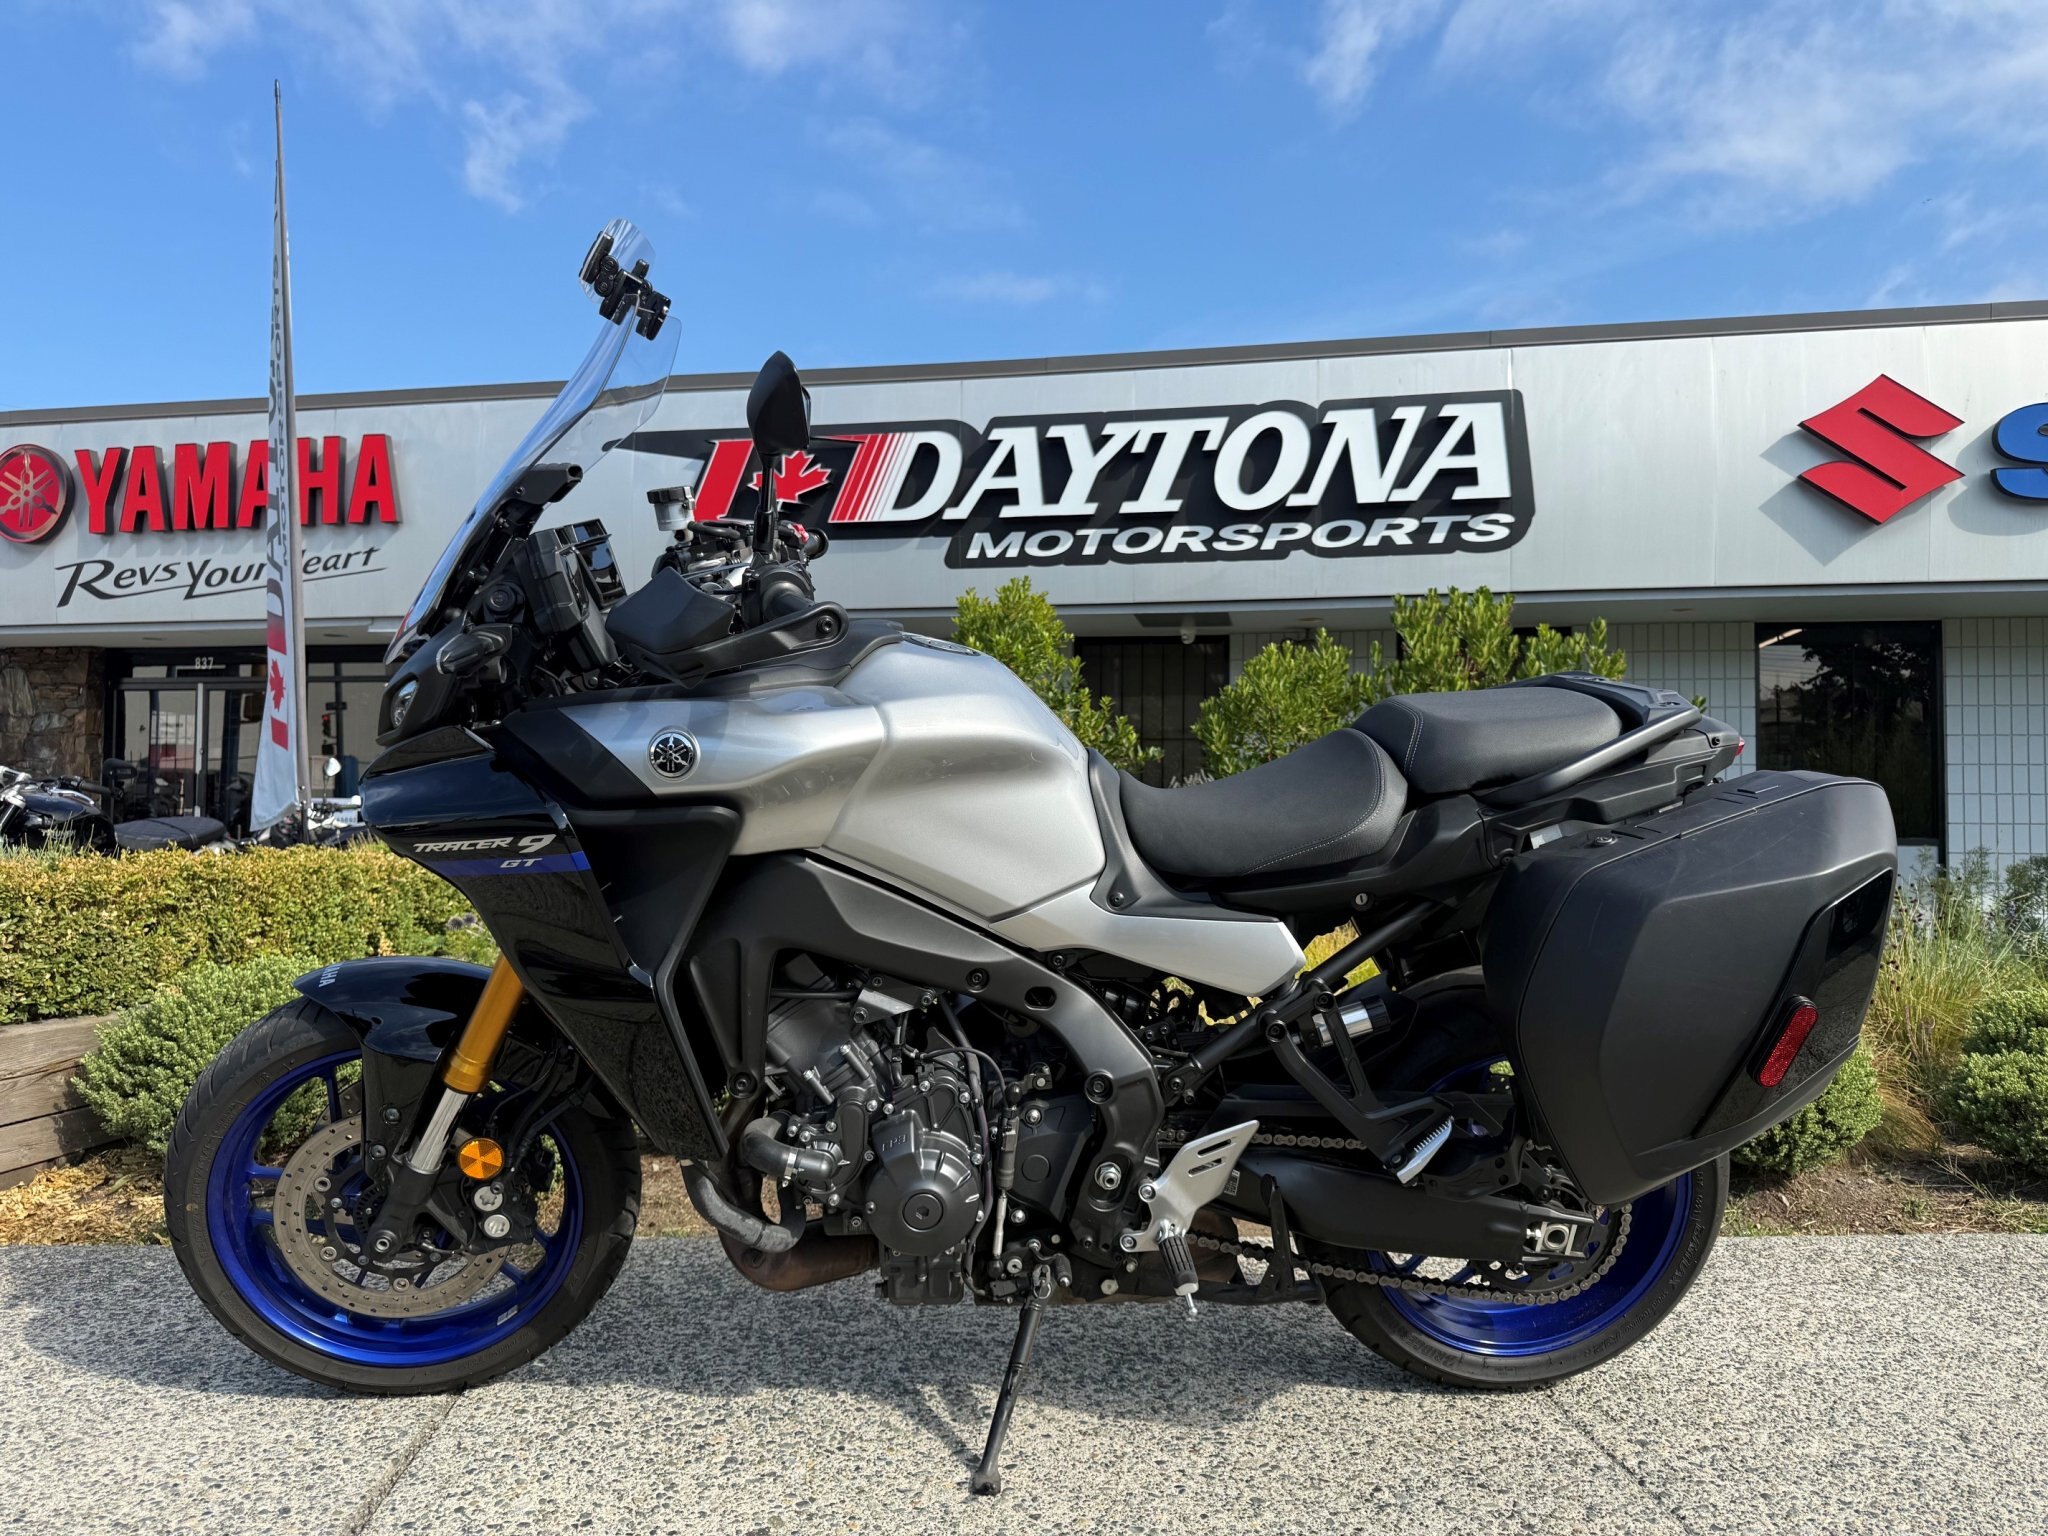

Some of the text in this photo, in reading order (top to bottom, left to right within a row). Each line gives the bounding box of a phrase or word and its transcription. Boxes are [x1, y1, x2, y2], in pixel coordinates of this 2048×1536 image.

[878, 402, 1512, 521] DAYTONA
[965, 513, 1516, 559] MOTORSPORTS
[55, 559, 183, 608] Revs
[302, 546, 381, 575] eart
[195, 656, 214, 670] 837
[413, 834, 557, 854] TRACER 9
[500, 858, 543, 868] GT
